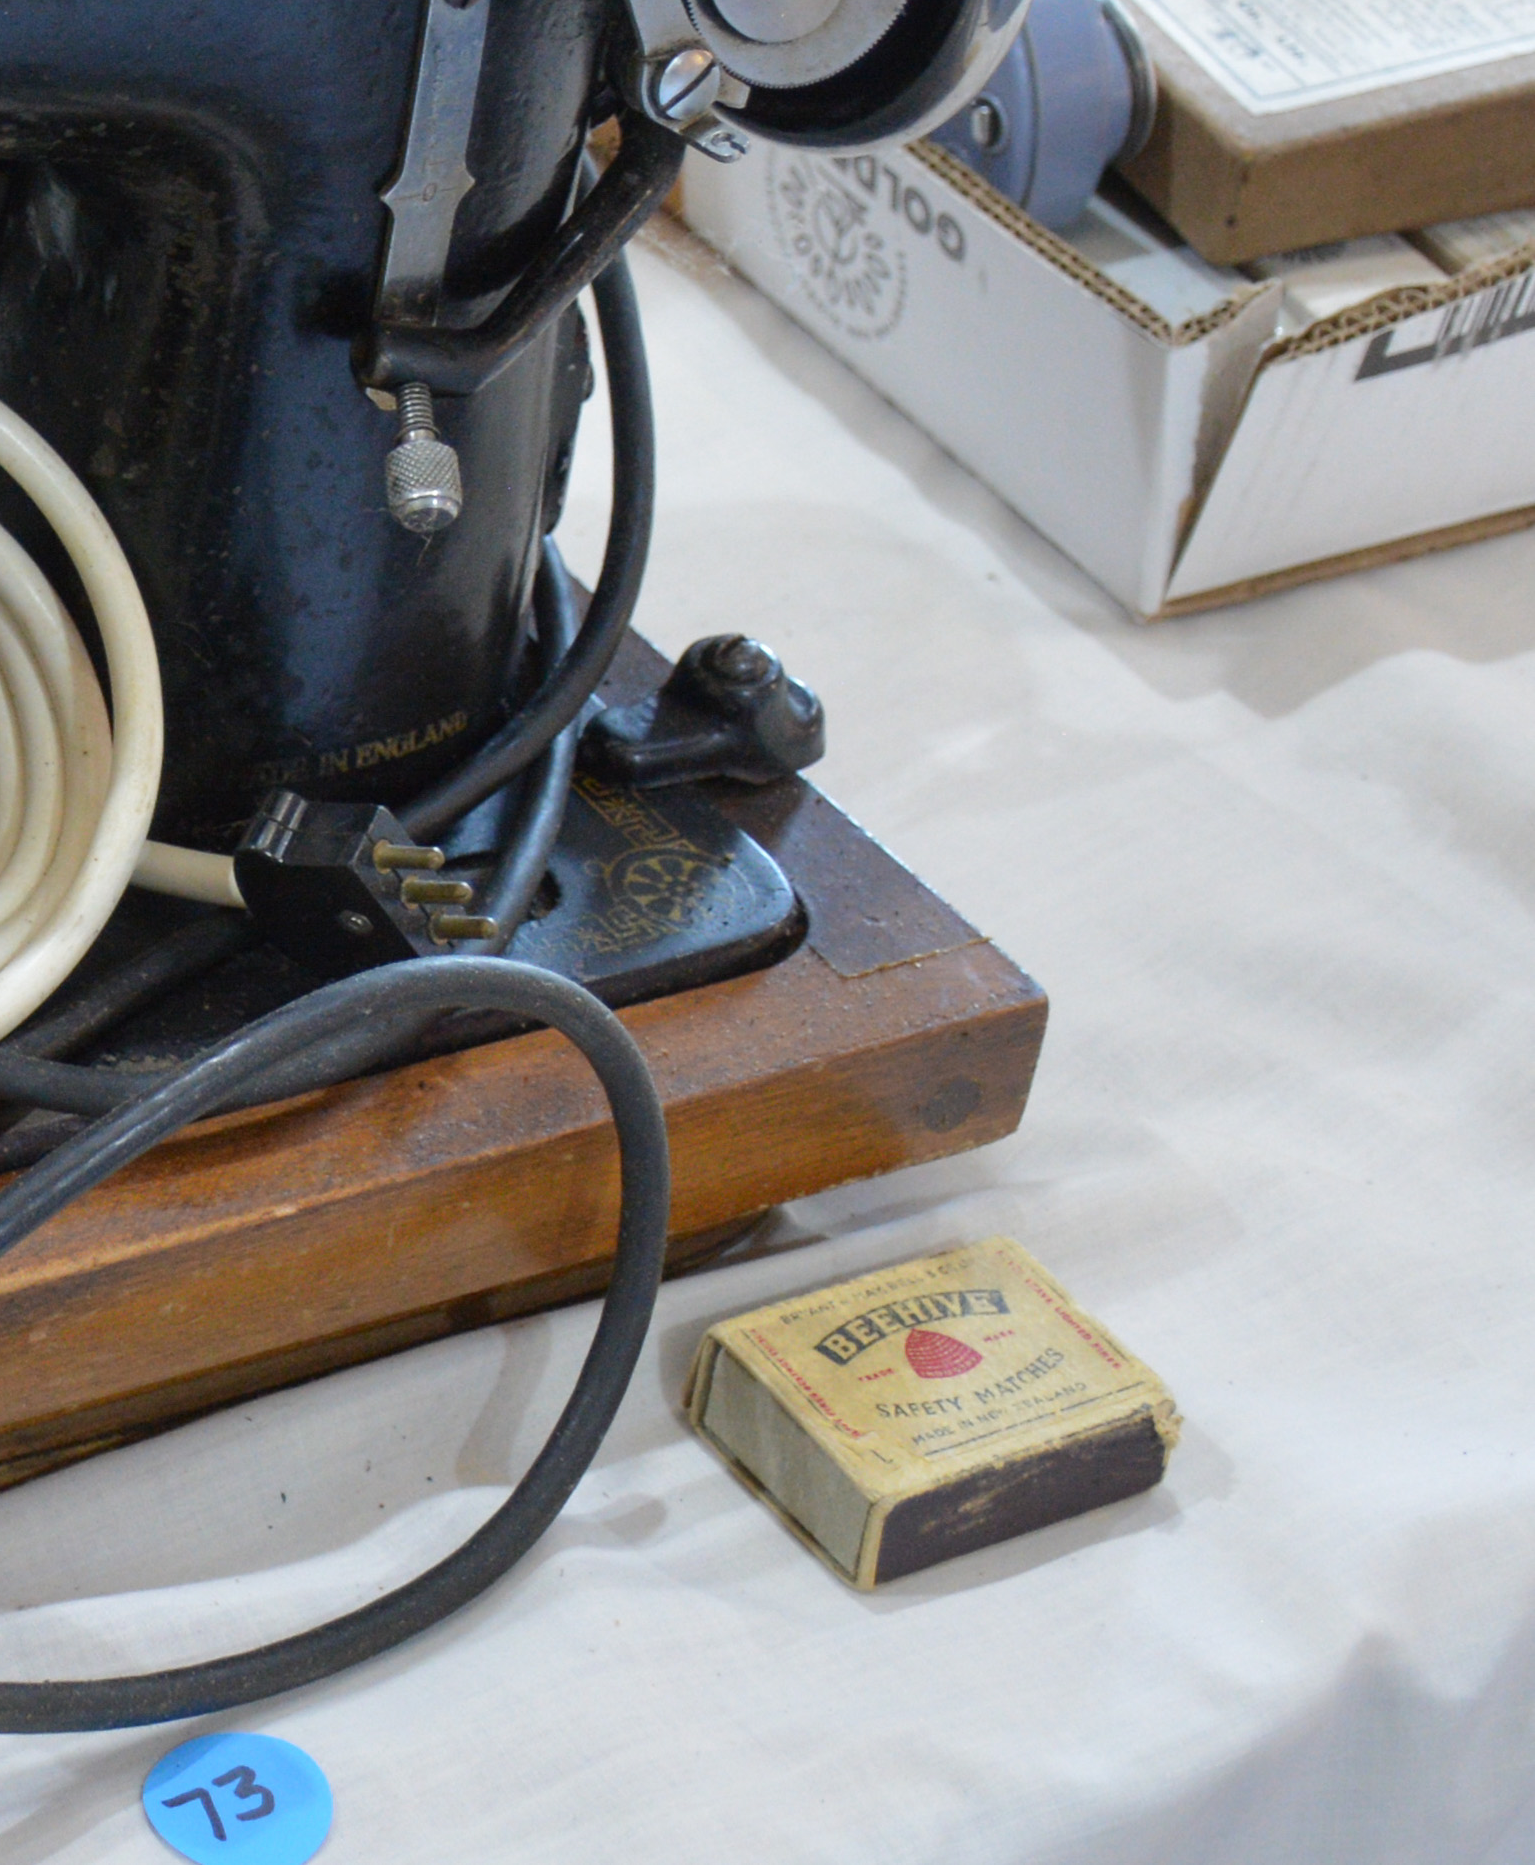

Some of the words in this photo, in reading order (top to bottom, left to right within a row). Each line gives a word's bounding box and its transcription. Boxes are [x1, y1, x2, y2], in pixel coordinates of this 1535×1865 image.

[355, 709, 468, 770] ENGLAND
[819, 1290, 1007, 1363] BEEHIVE
[857, 1366, 895, 1383] TRADE
[875, 1395, 963, 1419] SAFETY
[973, 1346, 1066, 1406] MATCHES
[911, 1424, 956, 1446] MADE
[957, 1417, 975, 1431] IN
[161, 1765, 276, 1842] 73
